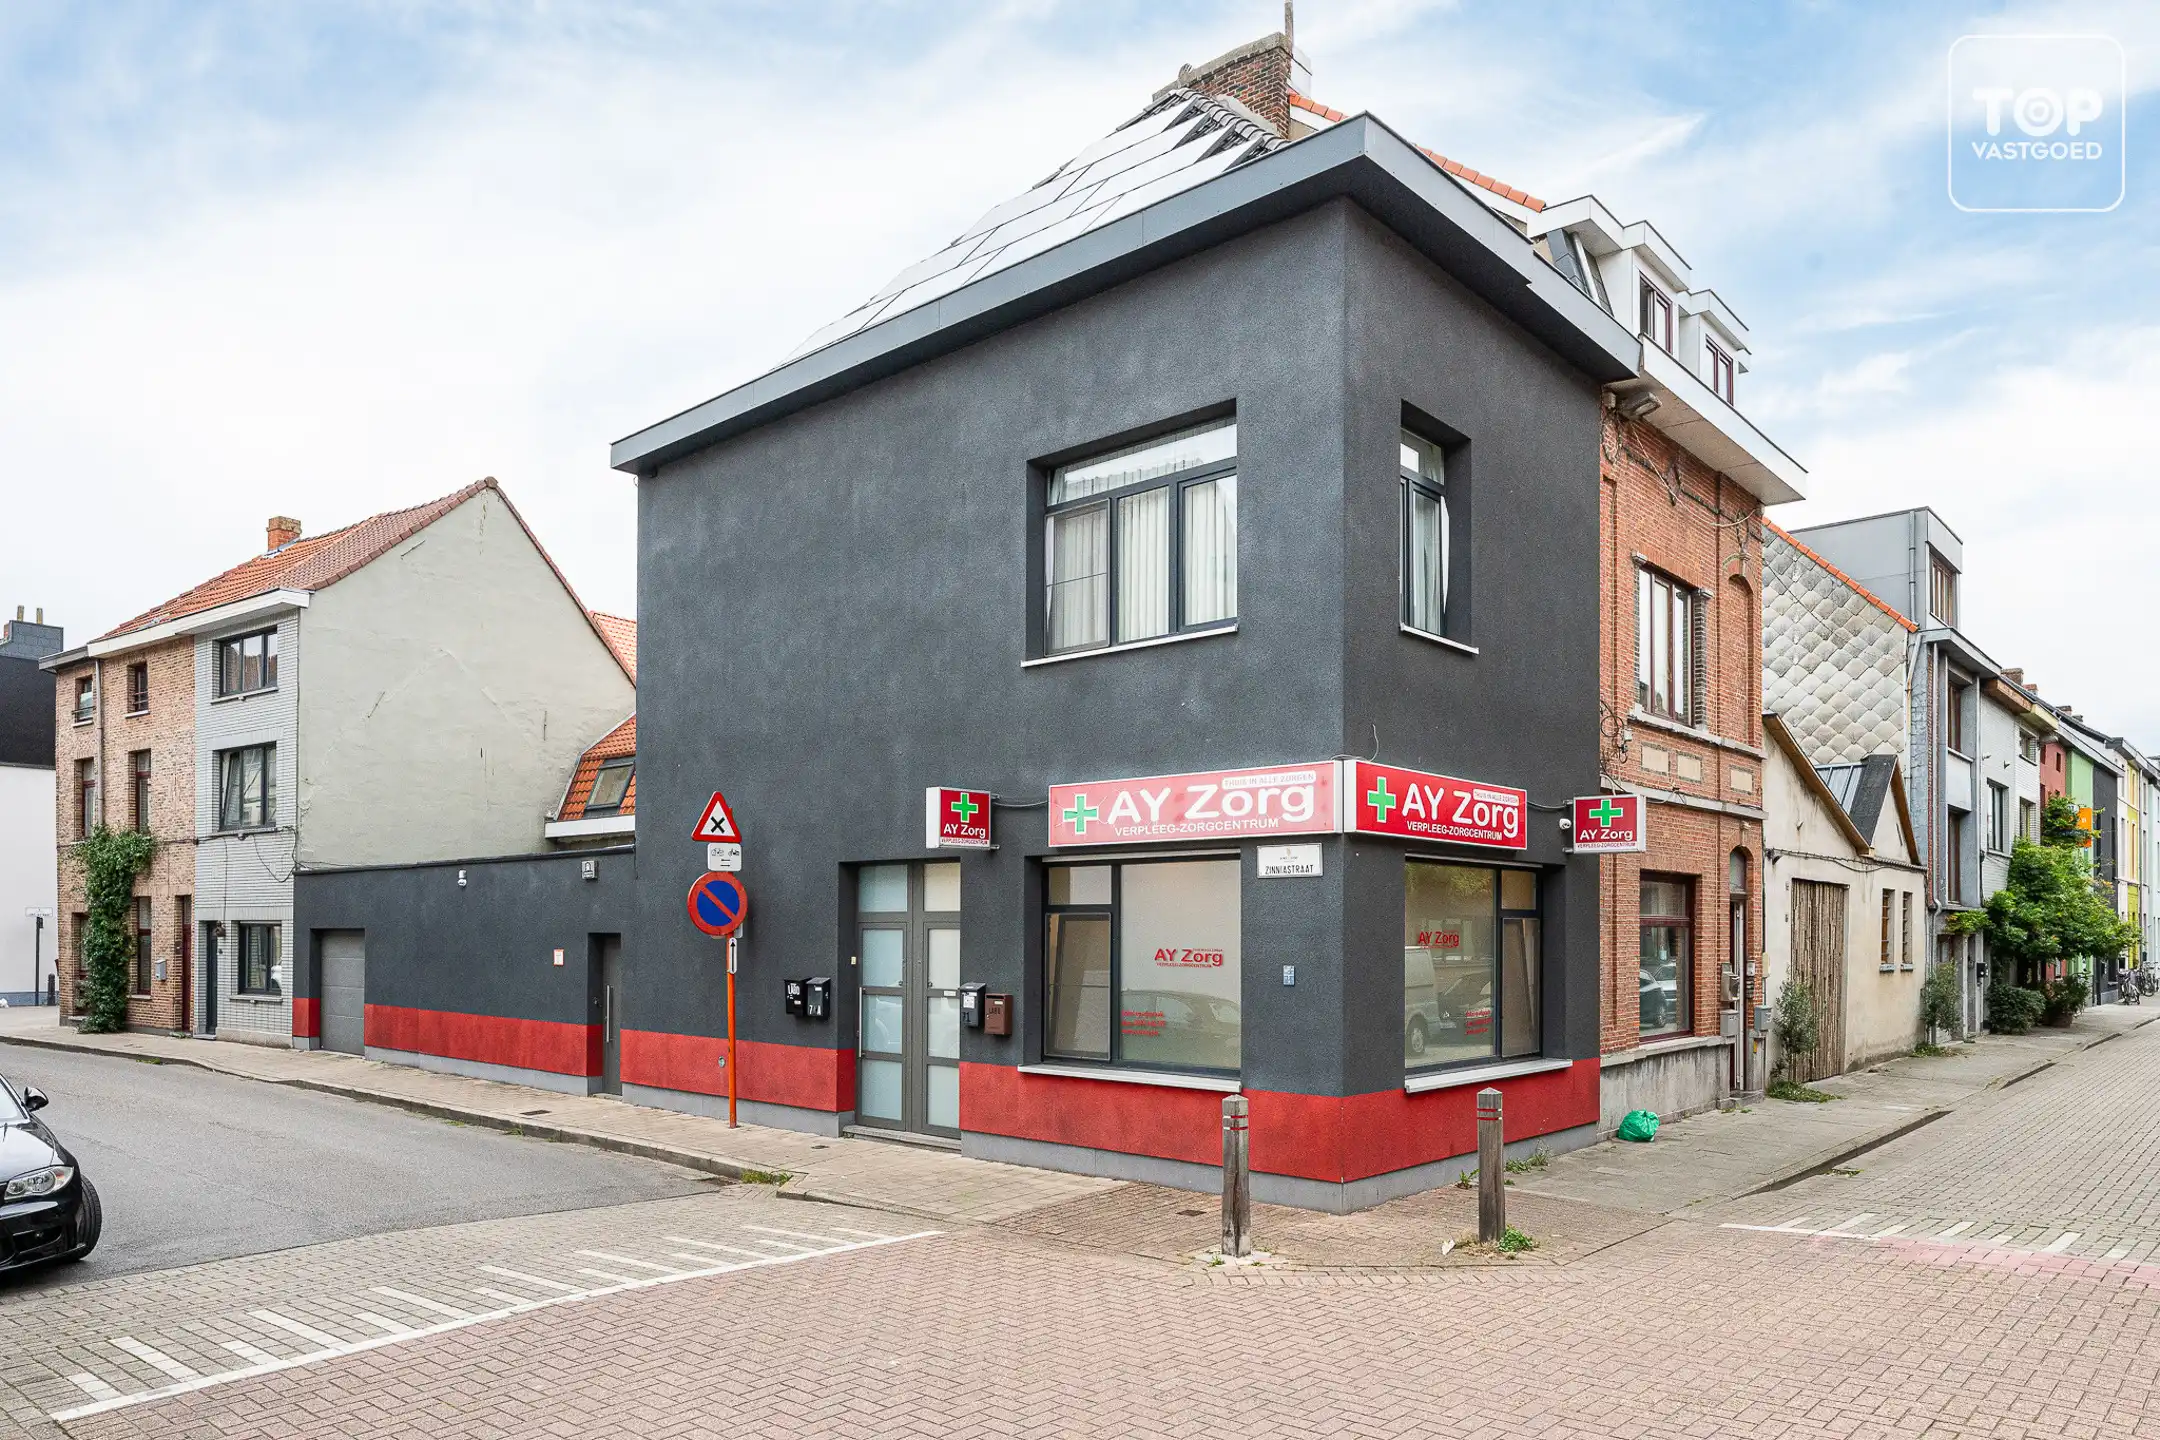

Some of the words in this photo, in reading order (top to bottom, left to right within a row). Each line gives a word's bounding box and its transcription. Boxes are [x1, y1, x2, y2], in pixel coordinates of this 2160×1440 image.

[1107, 787, 1171, 825] AY
[1184, 783, 1315, 823] Zorg
[1402, 782, 1445, 821] AY
[1452, 790, 1519, 839] Zorg
[943, 823, 958, 834] AY
[960, 824, 986, 839] Zorg
[1114, 817, 1279, 837] VERPLEEG-ZORGCENTRUM
[1406, 820, 1503, 841] VERPLEEG-ZORGCENTRUM
[1580, 829, 1598, 840] AY
[1600, 828, 1633, 841] Zorg
[1265, 864, 1314, 875] ZINNIASTRAAT
[1418, 931, 1432, 945] AY
[1435, 931, 1460, 947] Zorg
[1154, 948, 1177, 961] AY
[1181, 948, 1224, 967] Zorg
